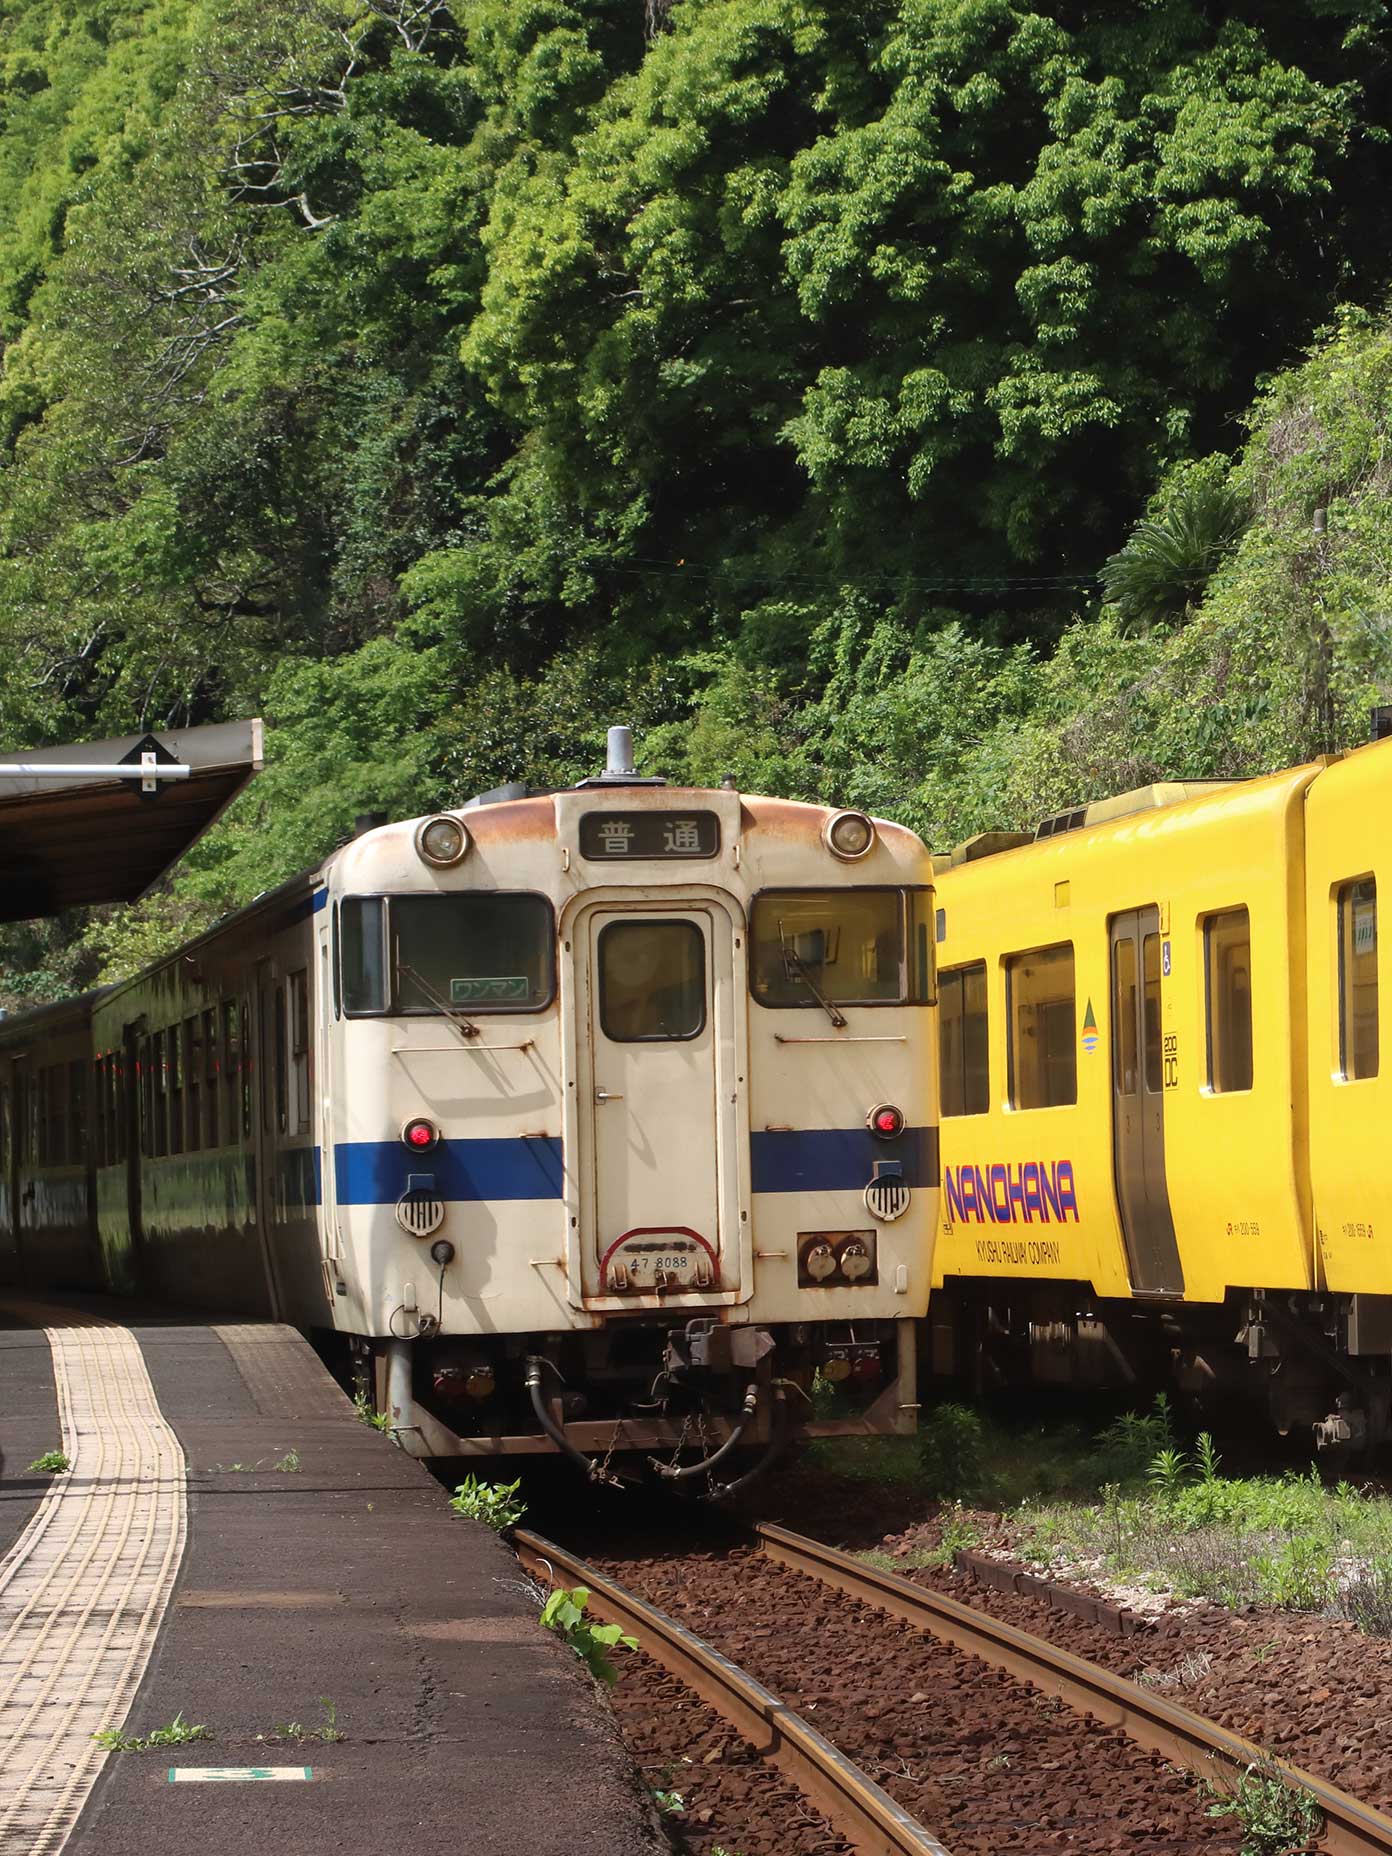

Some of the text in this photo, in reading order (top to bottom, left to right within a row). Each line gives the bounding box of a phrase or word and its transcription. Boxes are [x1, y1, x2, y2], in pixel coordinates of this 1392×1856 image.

[598, 821, 701, 853] 普通
[455, 981, 525, 999] ワンマン
[1164, 1035, 1177, 1052] 200
[1165, 1057, 1178, 1088] DC
[946, 1160, 1080, 1223] NANOHANA
[630, 1256, 688, 1270] 47 8088
[976, 1240, 1060, 1264] KYUSHU RAILWAY COMPANY
